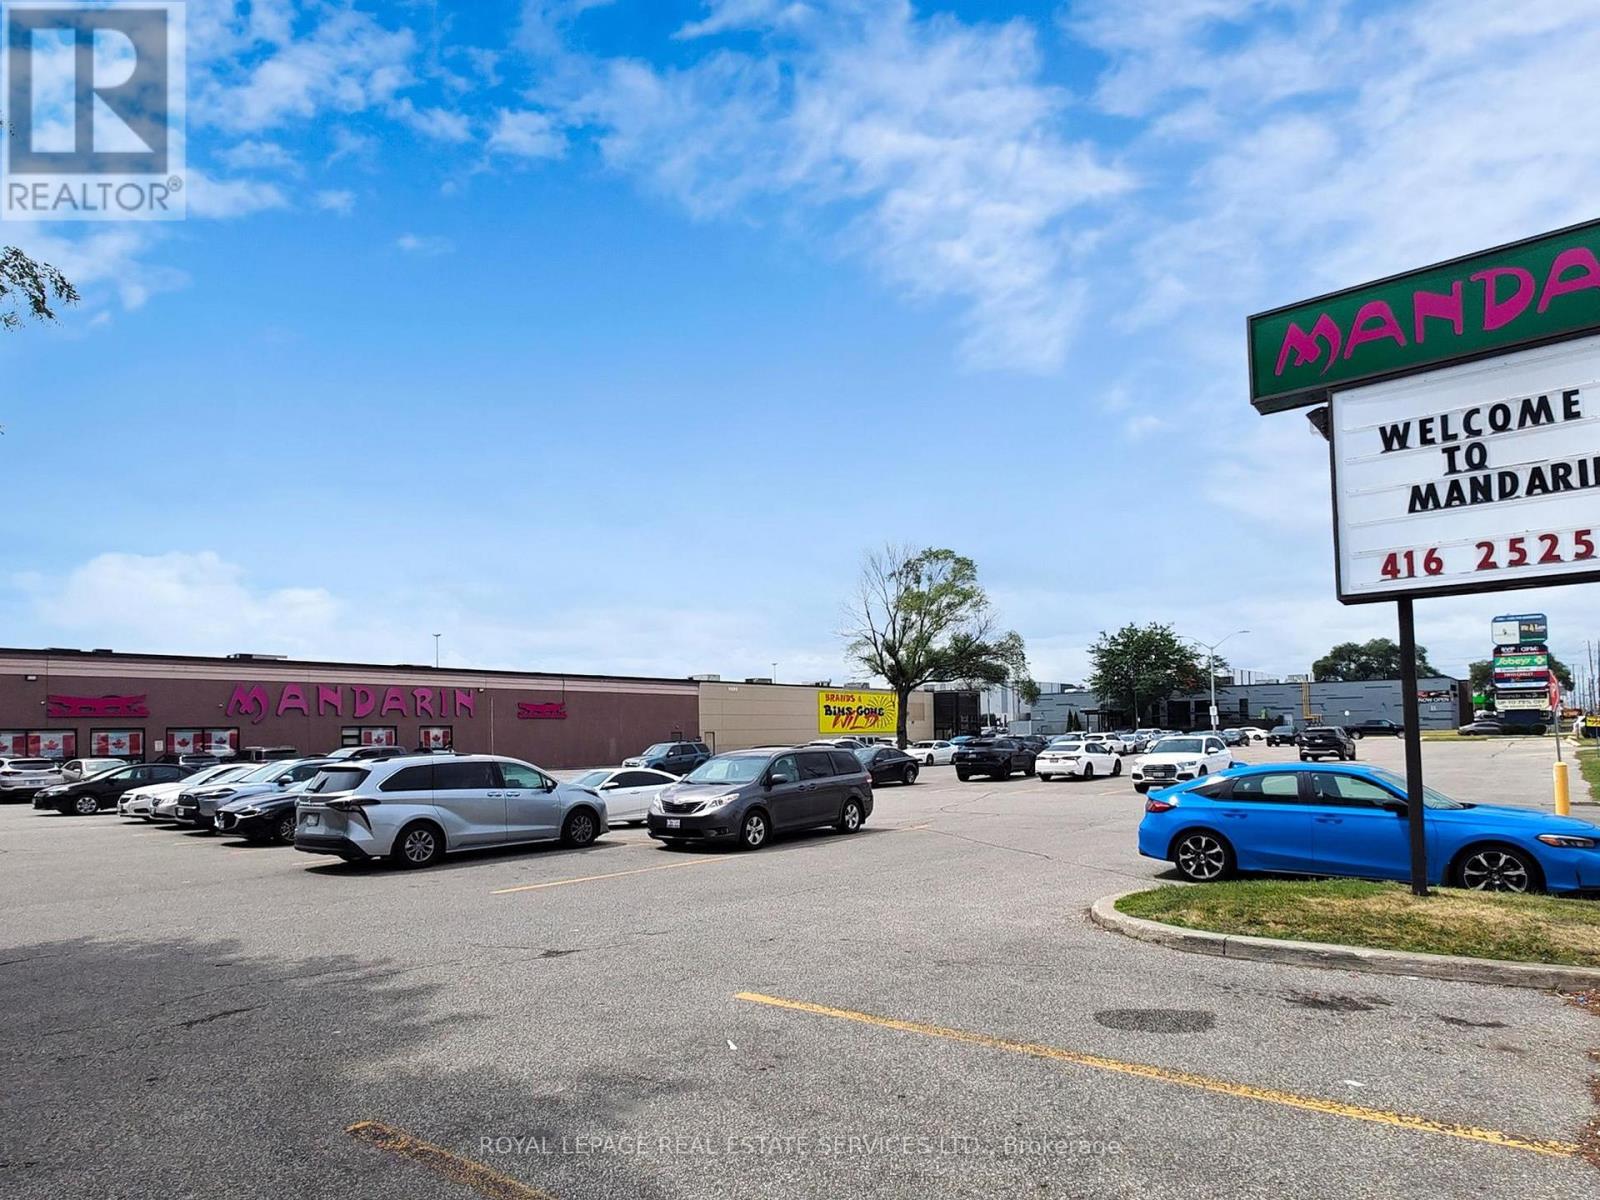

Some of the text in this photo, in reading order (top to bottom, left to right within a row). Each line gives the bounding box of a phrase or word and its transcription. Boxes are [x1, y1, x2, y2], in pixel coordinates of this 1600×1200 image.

[1379, 388, 1582, 452] WELCOME
[1442, 441, 1487, 475] TO
[1381, 529, 1595, 580] 416 2525
[226, 683, 475, 724] MANDARIN
[825, 693, 855, 703] BRANDS
[832, 710, 880, 730] WILD
